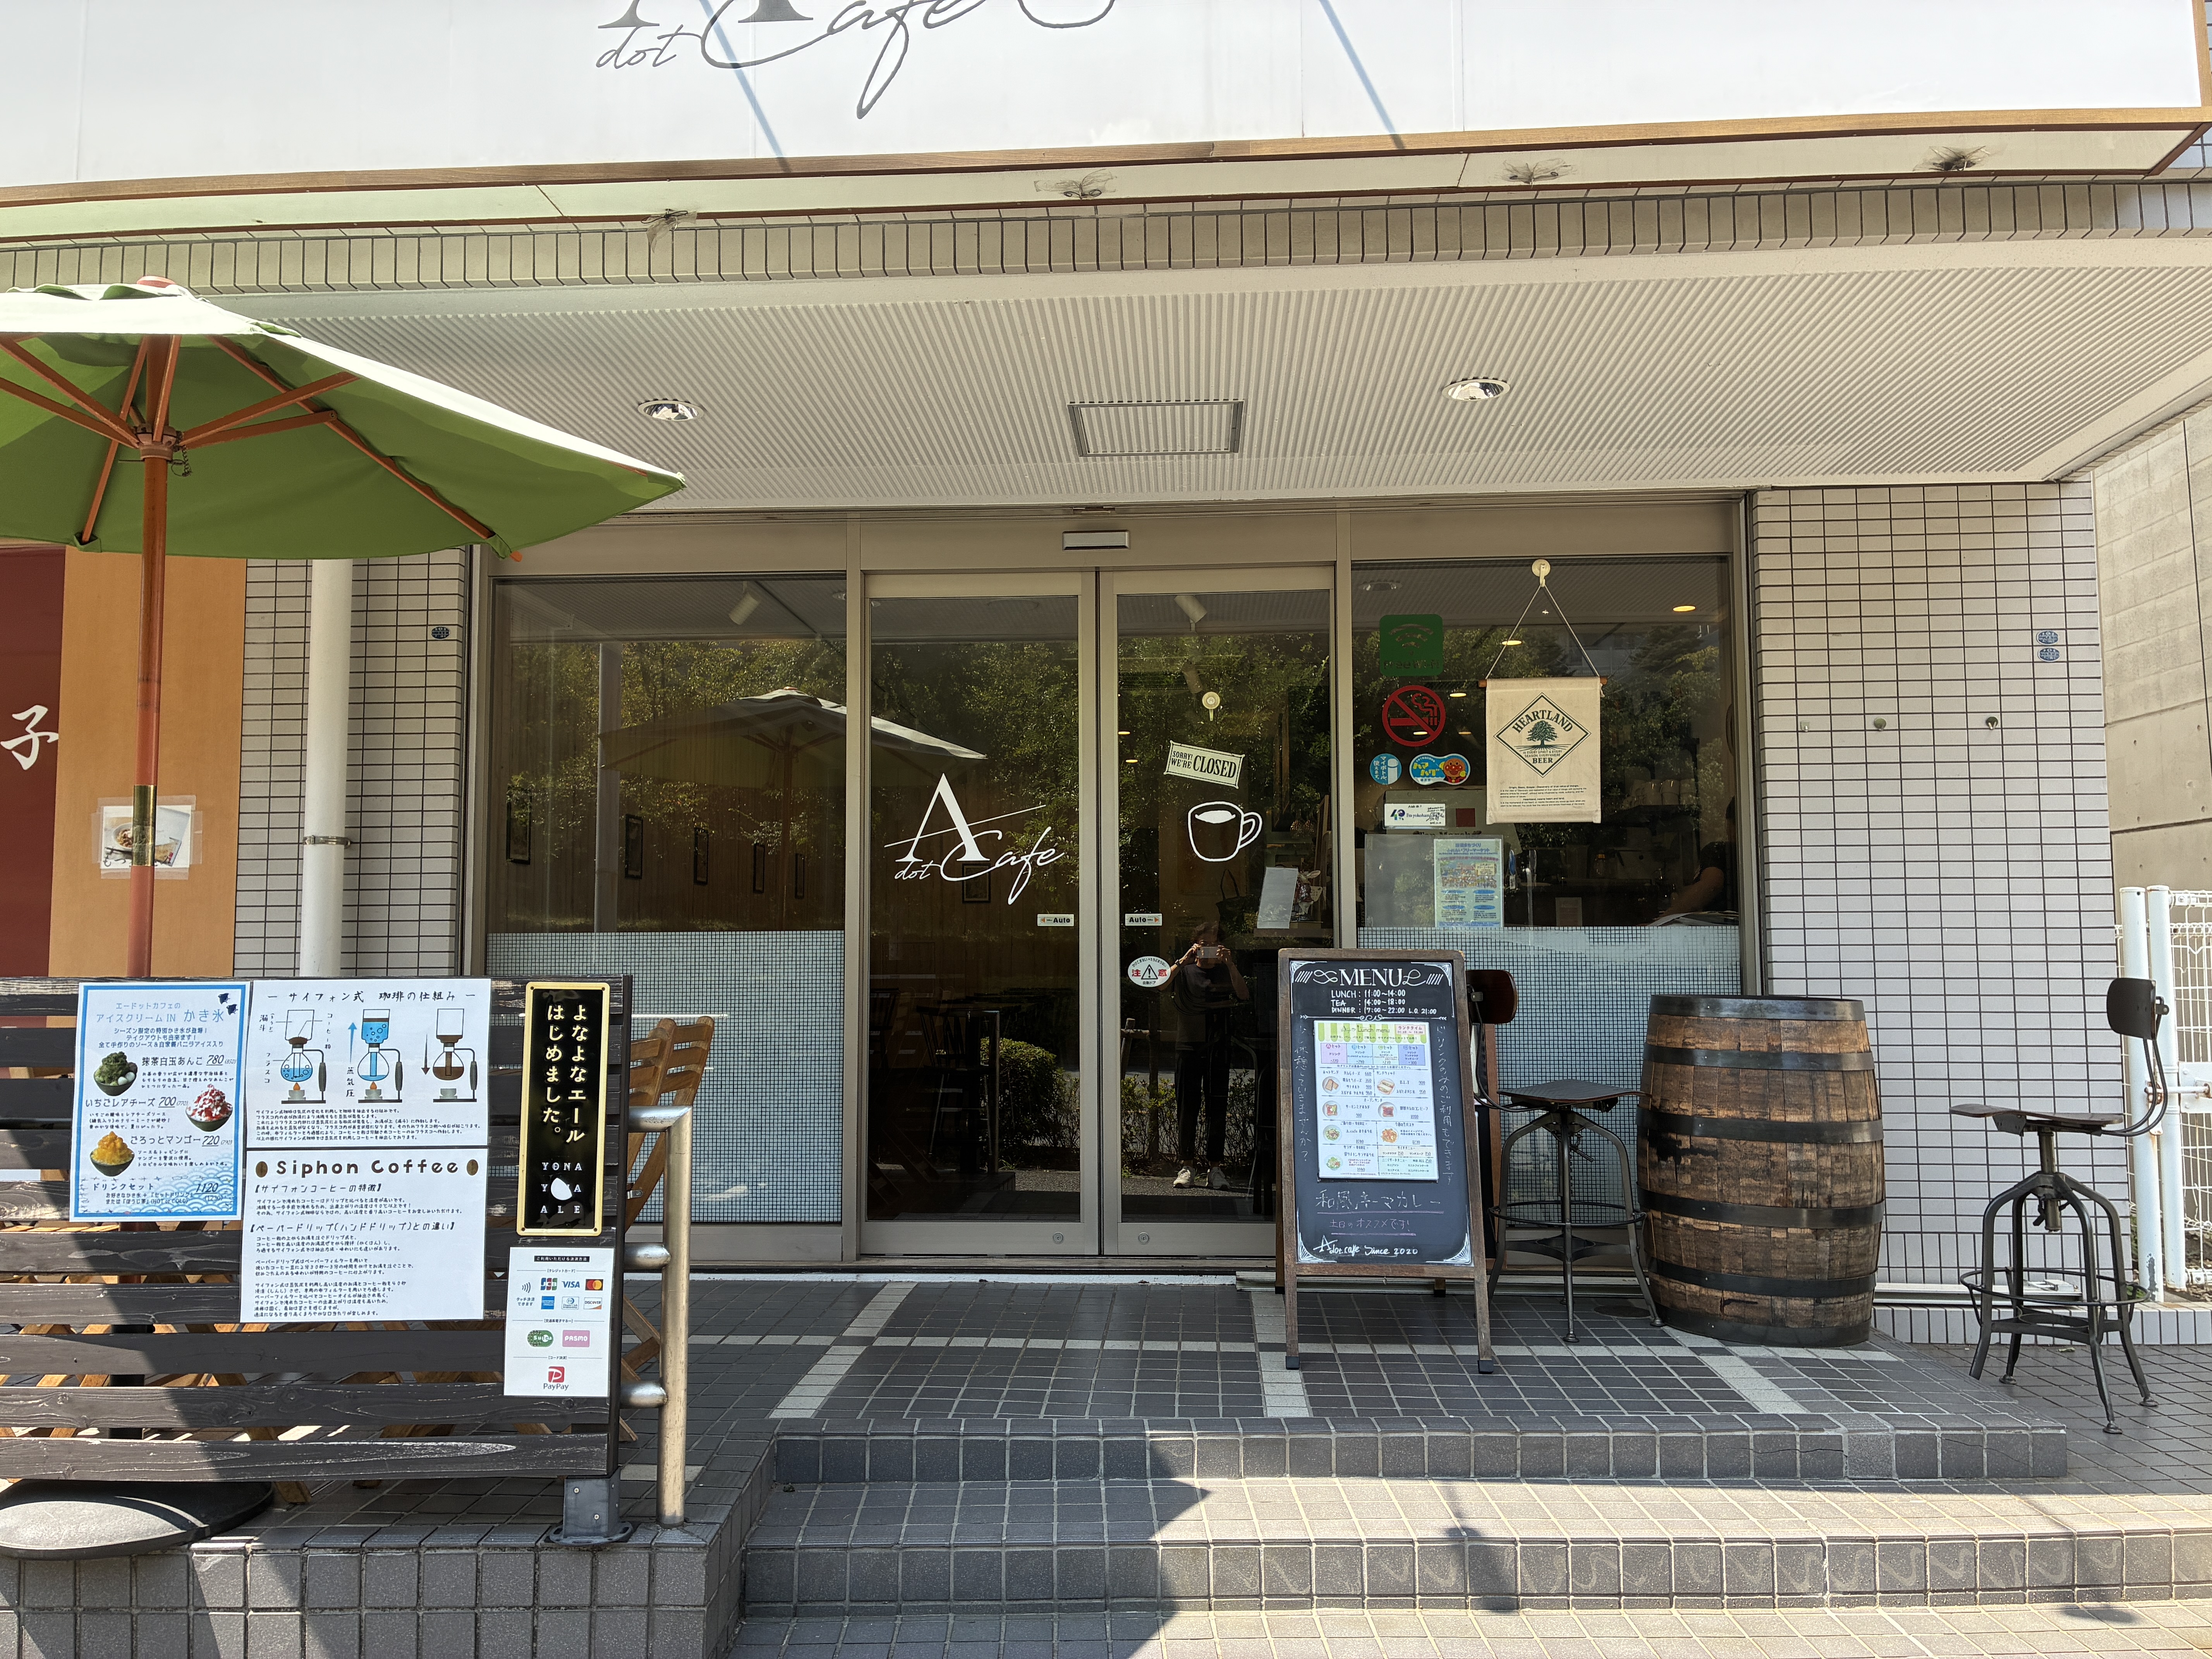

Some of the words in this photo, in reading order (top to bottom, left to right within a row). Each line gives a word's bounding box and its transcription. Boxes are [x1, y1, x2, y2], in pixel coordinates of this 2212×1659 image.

[596, 24, 685, 68] dot
[1512, 710, 1573, 733] HEARTLAND
[0, 705, 59, 770] 子
[1172, 750, 1193, 761] SORRY!
[1171, 757, 1192, 769] WE'RE
[1193, 755, 1237, 779] CLOSED
[895, 773, 990, 861] A
[895, 860, 934, 880] dot
[940, 826, 1065, 905] Cafe
[1339, 969, 1404, 987] MENU
[289, 991, 365, 1002] サイフォン式
[378, 991, 456, 1001] 珈琲の仕組み
[1331, 990, 1356, 998] LUNCH
[96, 1014, 163, 1023] アイスクリーム
[184, 1009, 224, 1022] かき氷
[259, 1014, 268, 1032] 漏斗
[142, 1056, 203, 1066] 抹茶白玉あんこ
[206, 1054, 225, 1065] 780
[543, 1005, 565, 1133] はじめました。
[566, 1005, 588, 1144] よなよなエール
[345, 1066, 355, 1097] 蒸気圧
[85, 1098, 155, 1108] いちごレアチーズ
[158, 1096, 177, 1108] 700
[130, 1135, 201, 1145] ごろっとマンゴー
[202, 1135, 220, 1146] 720
[276, 1161, 359, 1178] Siphon
[371, 1159, 459, 1174] Coffee
[541, 1162, 582, 1171] YONA
[195, 1183, 218, 1194] 1120
[541, 1184, 582, 1193] YA
[540, 1206, 580, 1214] ALE
[1364, 1245, 1390, 1255] Since
